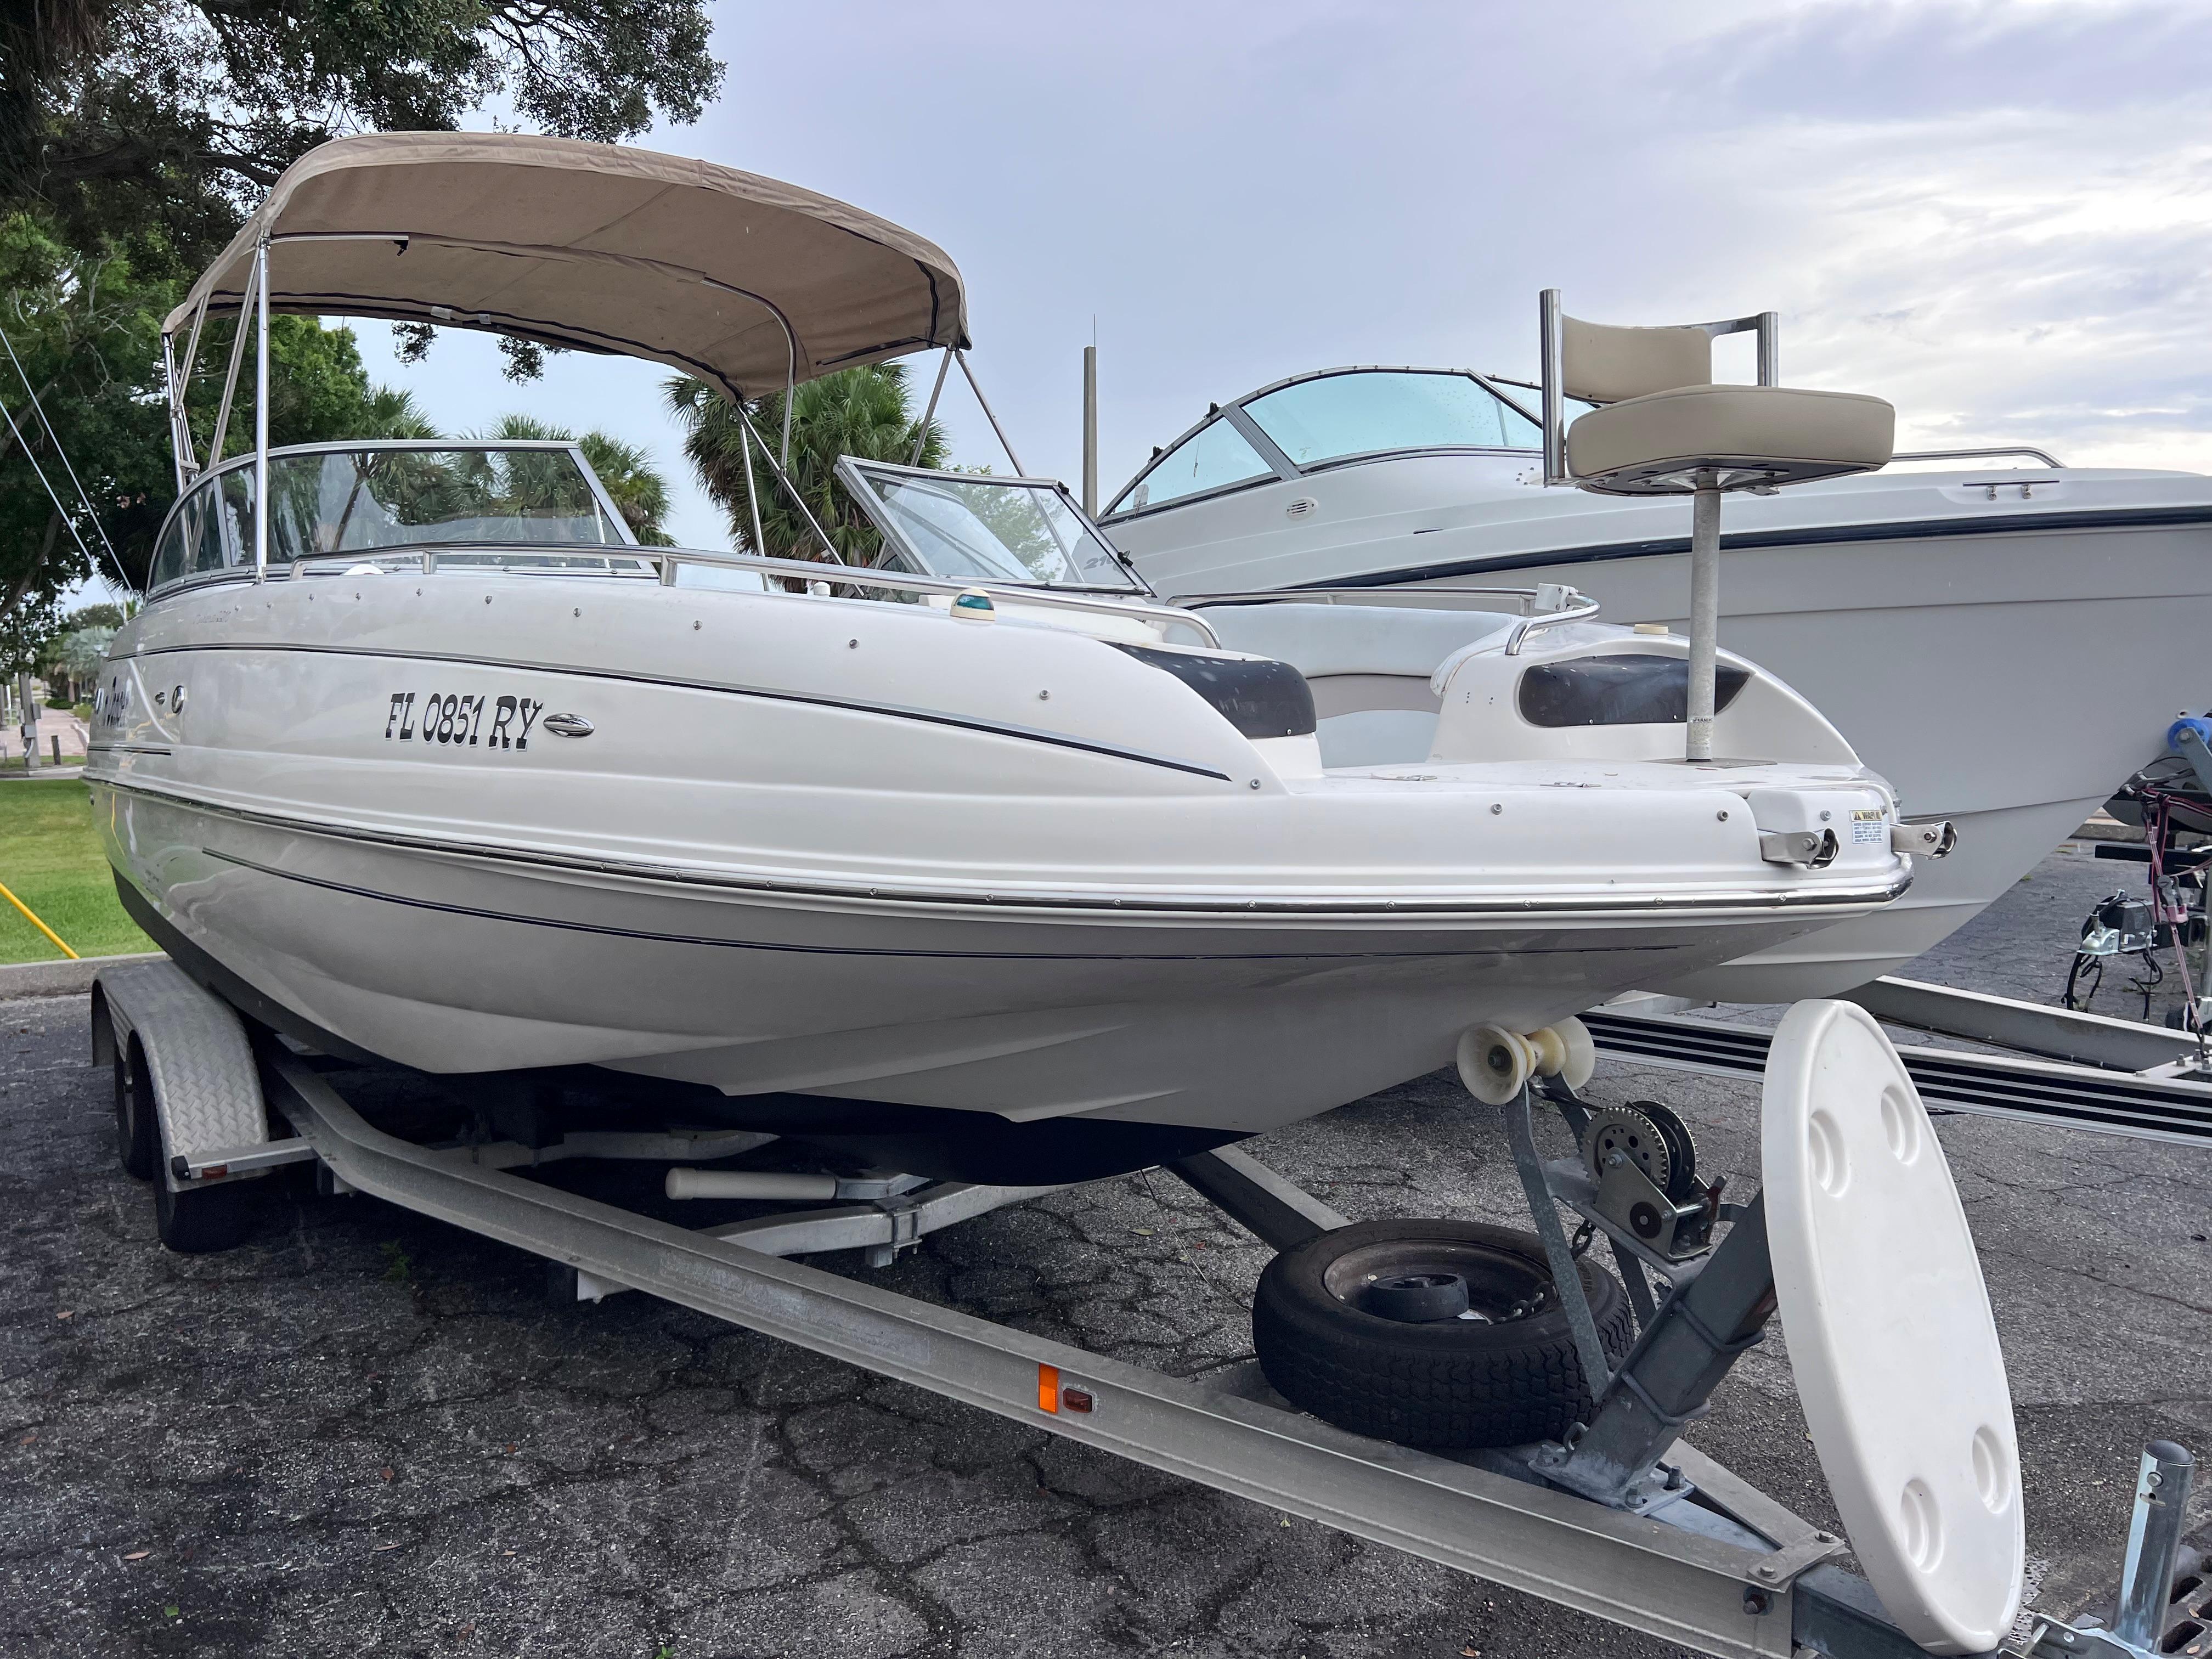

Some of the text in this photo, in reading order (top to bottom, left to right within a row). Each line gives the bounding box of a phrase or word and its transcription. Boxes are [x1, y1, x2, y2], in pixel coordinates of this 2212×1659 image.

[385, 692, 544, 749] FL 0851 RY
